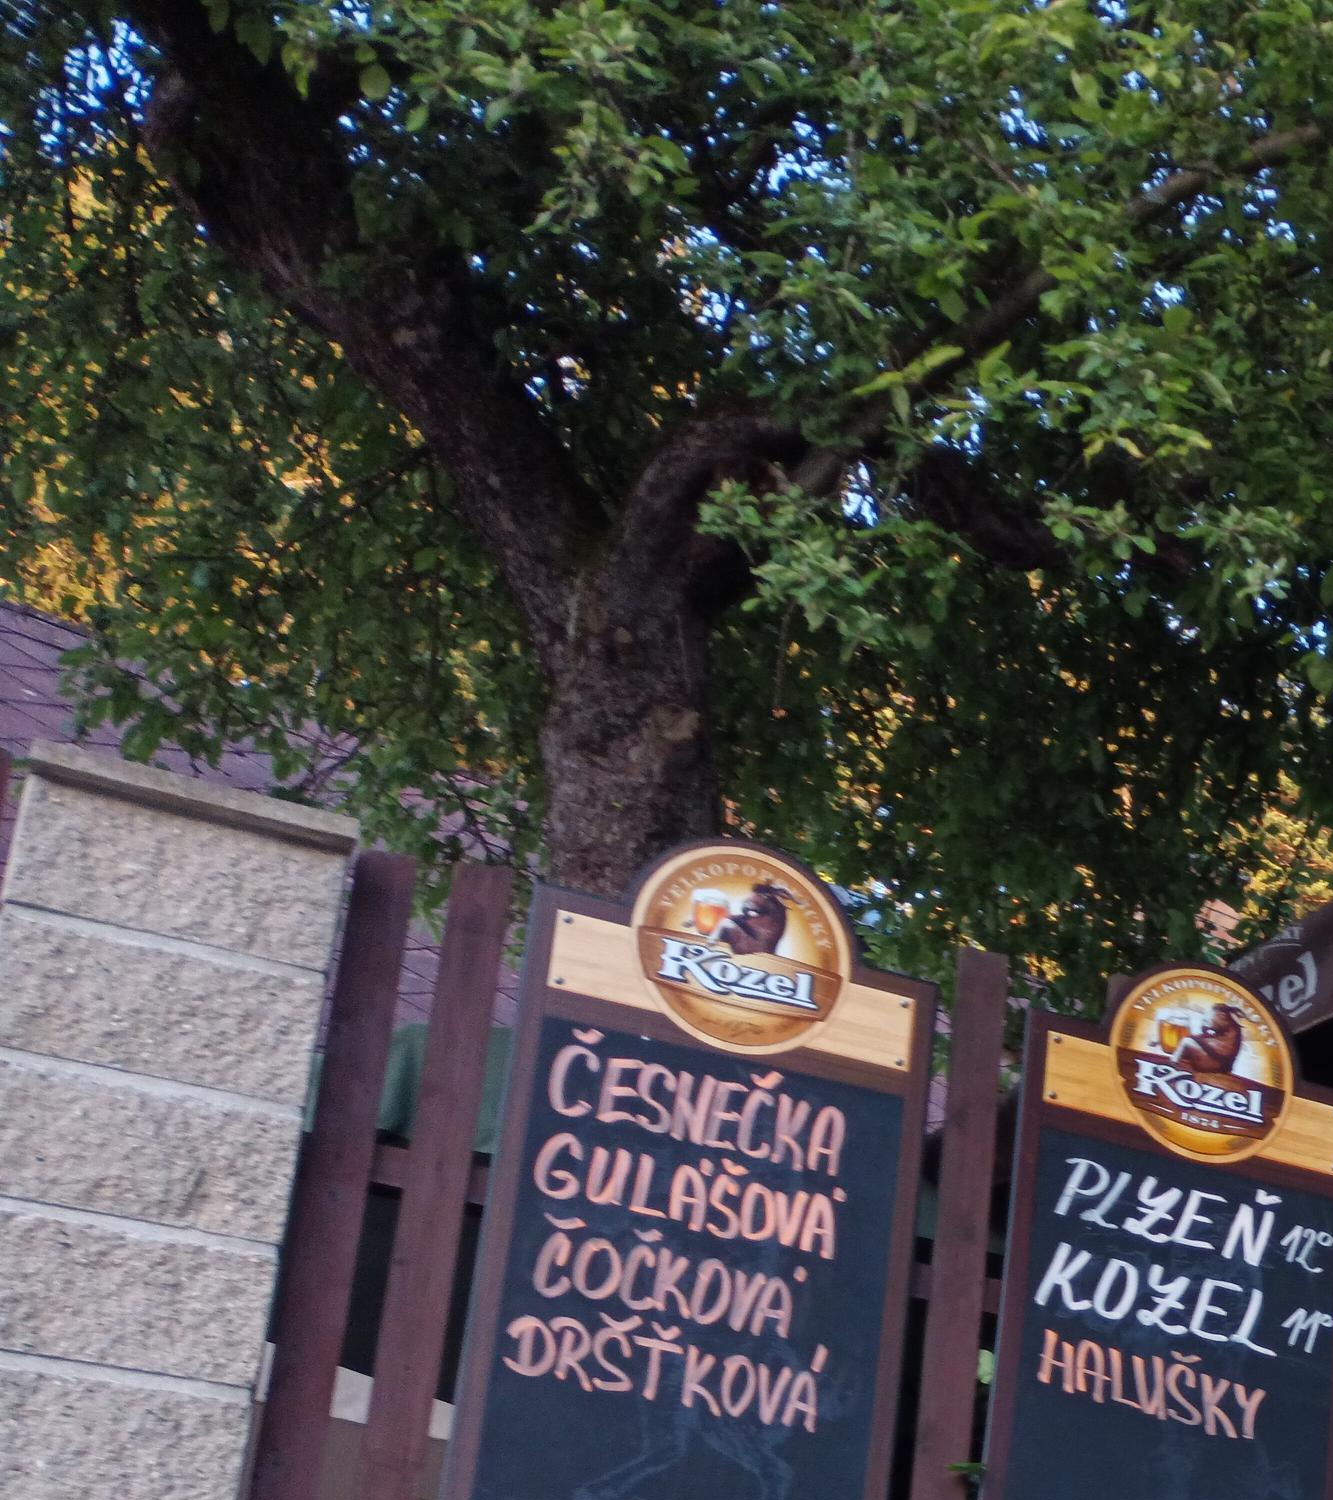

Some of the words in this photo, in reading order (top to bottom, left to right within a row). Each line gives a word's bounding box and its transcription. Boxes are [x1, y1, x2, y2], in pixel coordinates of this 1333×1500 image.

[657, 936, 819, 1010] Kozel
[548, 1028, 846, 1176] ČESNEČKA
[1133, 1058, 1264, 1123] Kozel
[533, 1131, 846, 1261] GULÁŠOVÁ
[1053, 1157, 1281, 1268] PLZEŇ
[531, 1214, 807, 1340] ČOČKOVÁ
[1034, 1242, 1277, 1357] KOZEL
[503, 1315, 828, 1432] DRŠŤKOVÁ
[1036, 1328, 1266, 1439] HALUŠKY
